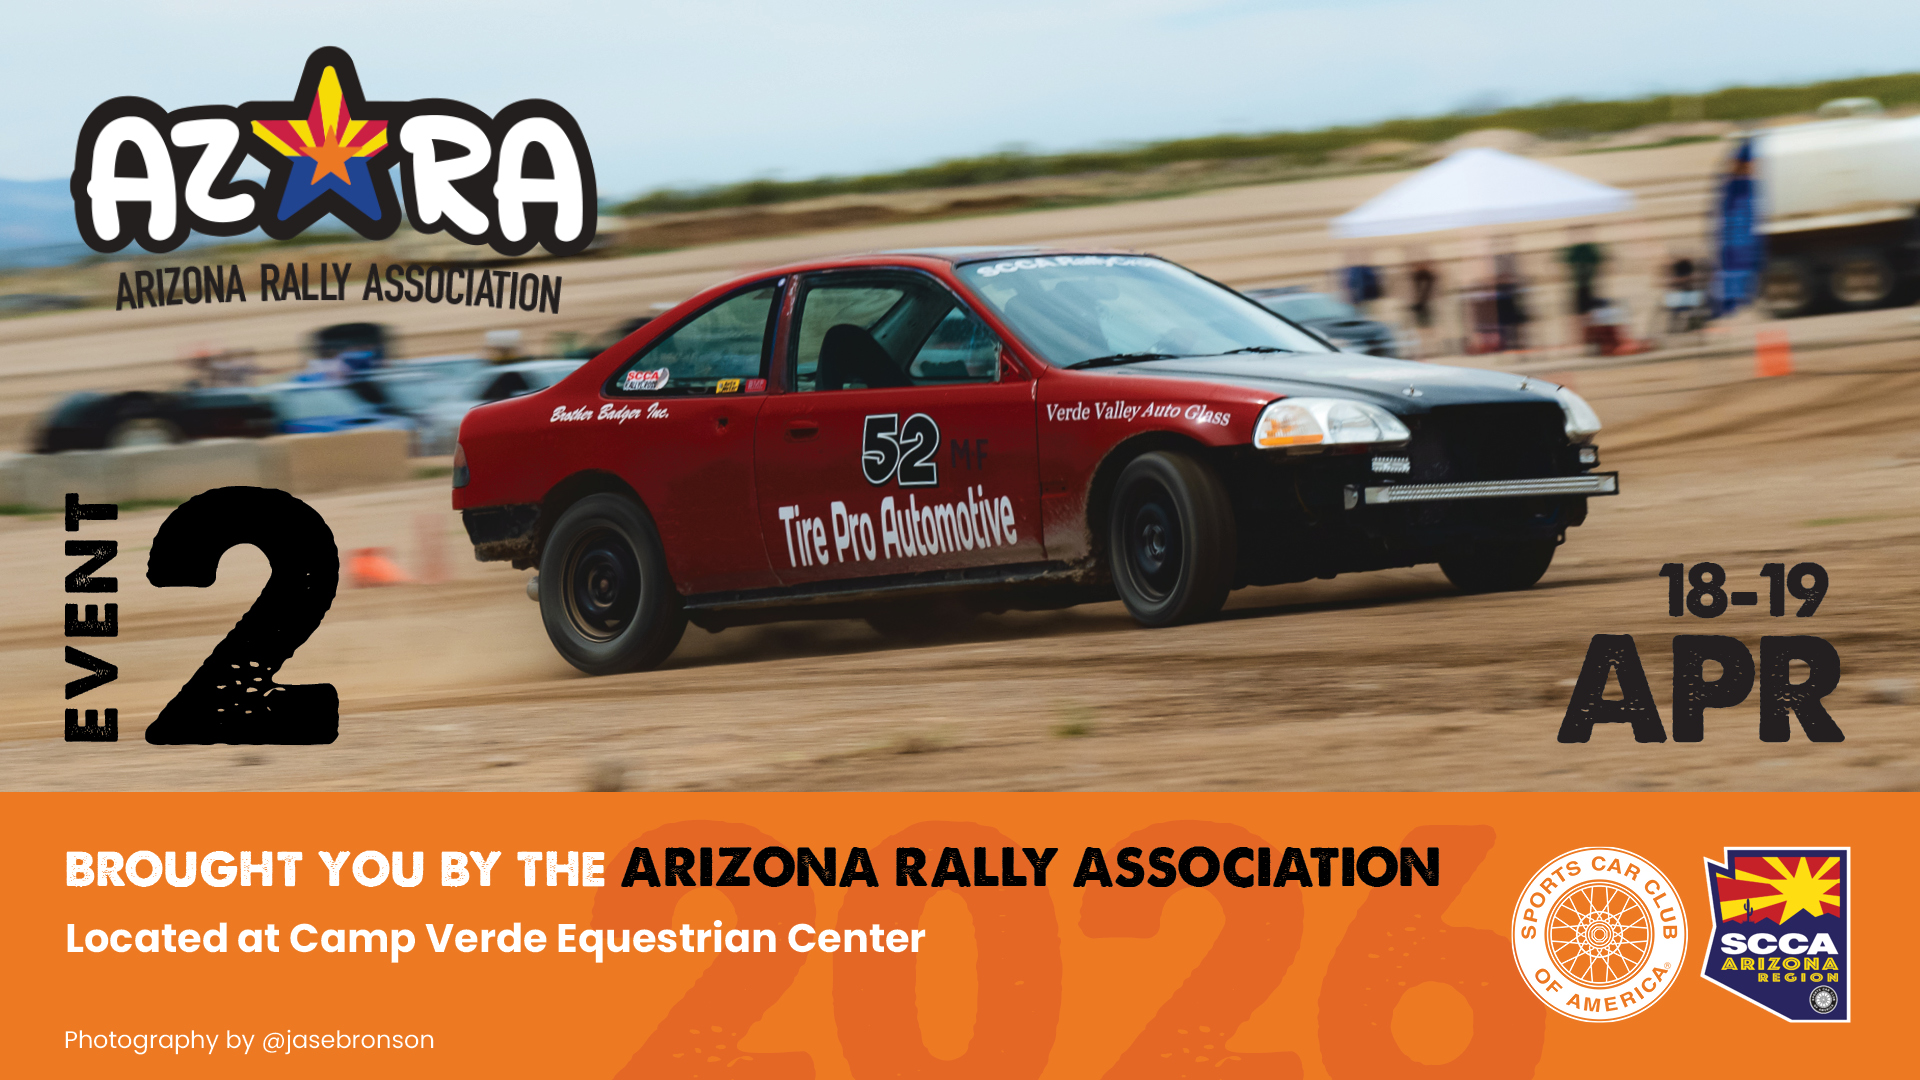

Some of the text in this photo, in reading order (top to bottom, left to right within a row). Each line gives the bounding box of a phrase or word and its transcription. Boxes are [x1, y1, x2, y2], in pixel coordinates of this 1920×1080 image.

[976, 257, 1055, 277] SCCA
[627, 370, 659, 381] SCCA
[550, 402, 669, 425] Brother Badger Inc.
[1046, 401, 1231, 427] Verde Valley Auto Glass
[861, 413, 939, 487] 52
[778, 484, 1017, 568] Tire Pro Automotive
